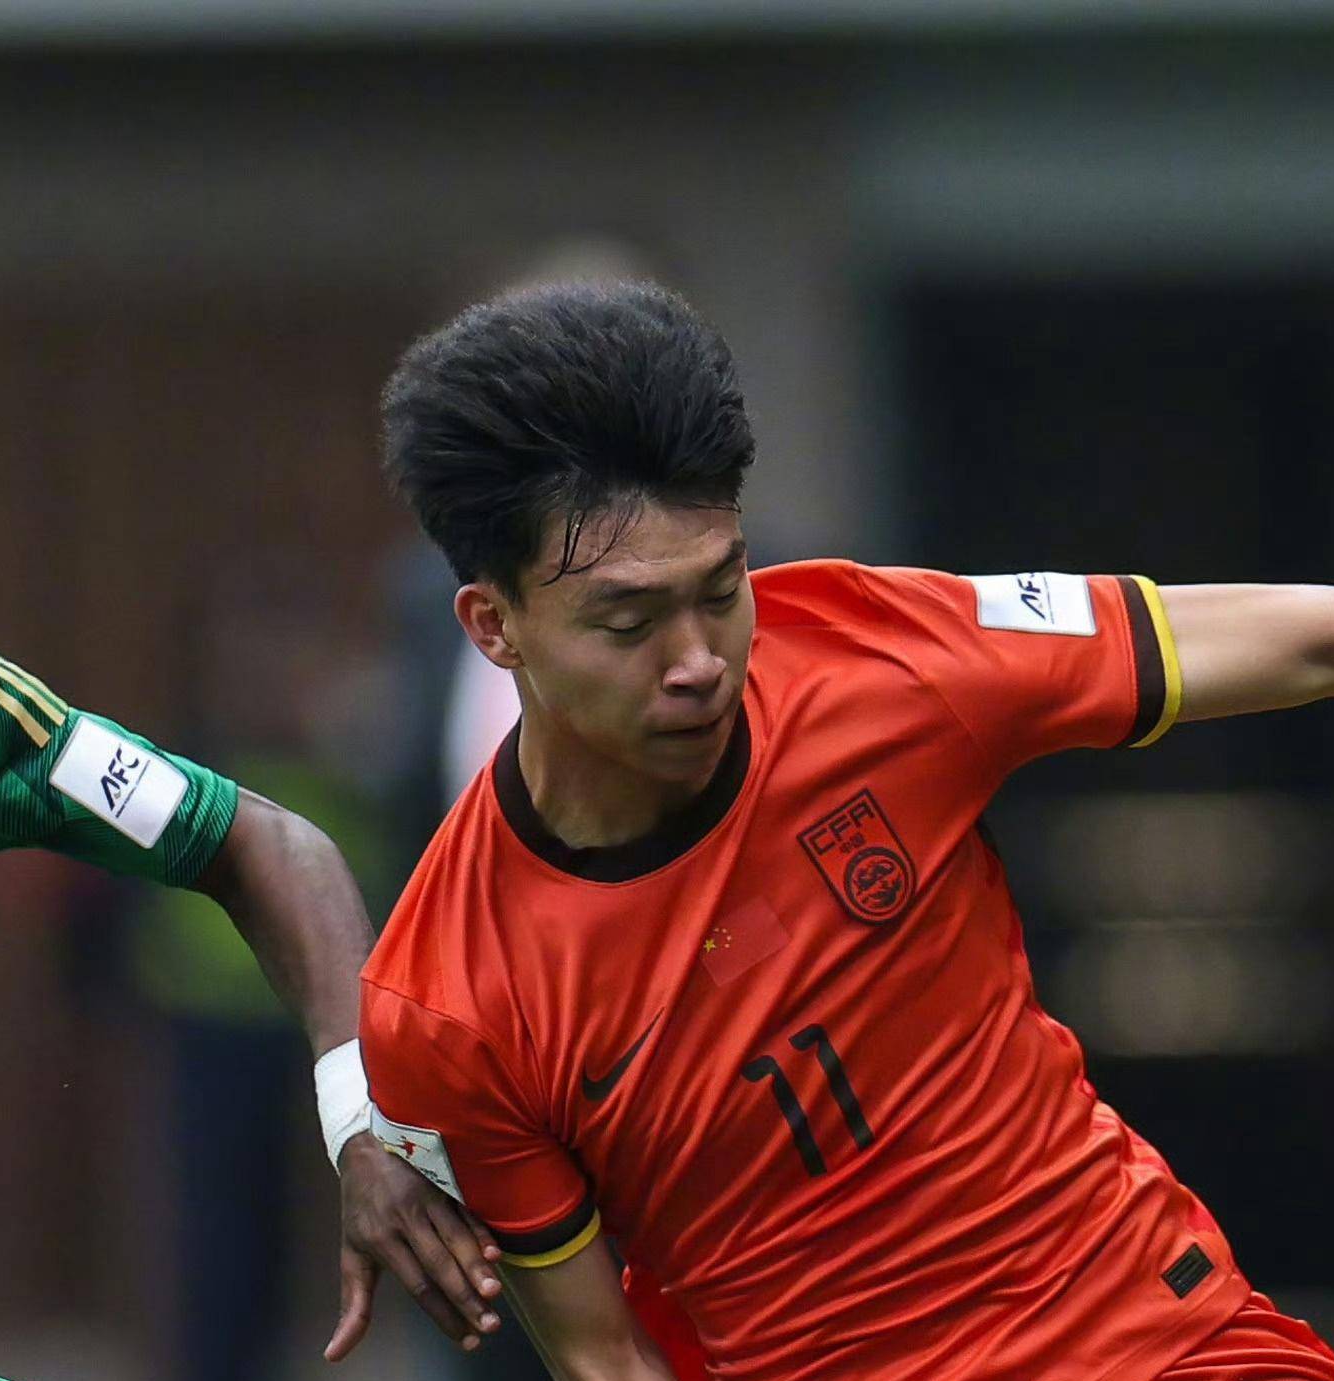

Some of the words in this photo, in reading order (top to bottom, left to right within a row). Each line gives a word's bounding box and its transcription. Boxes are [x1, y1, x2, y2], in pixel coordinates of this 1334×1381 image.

[1017, 571, 1046, 620] AF
[100, 744, 140, 812] AFC
[809, 802, 875, 856] CFA
[741, 1022, 875, 1178] 11
